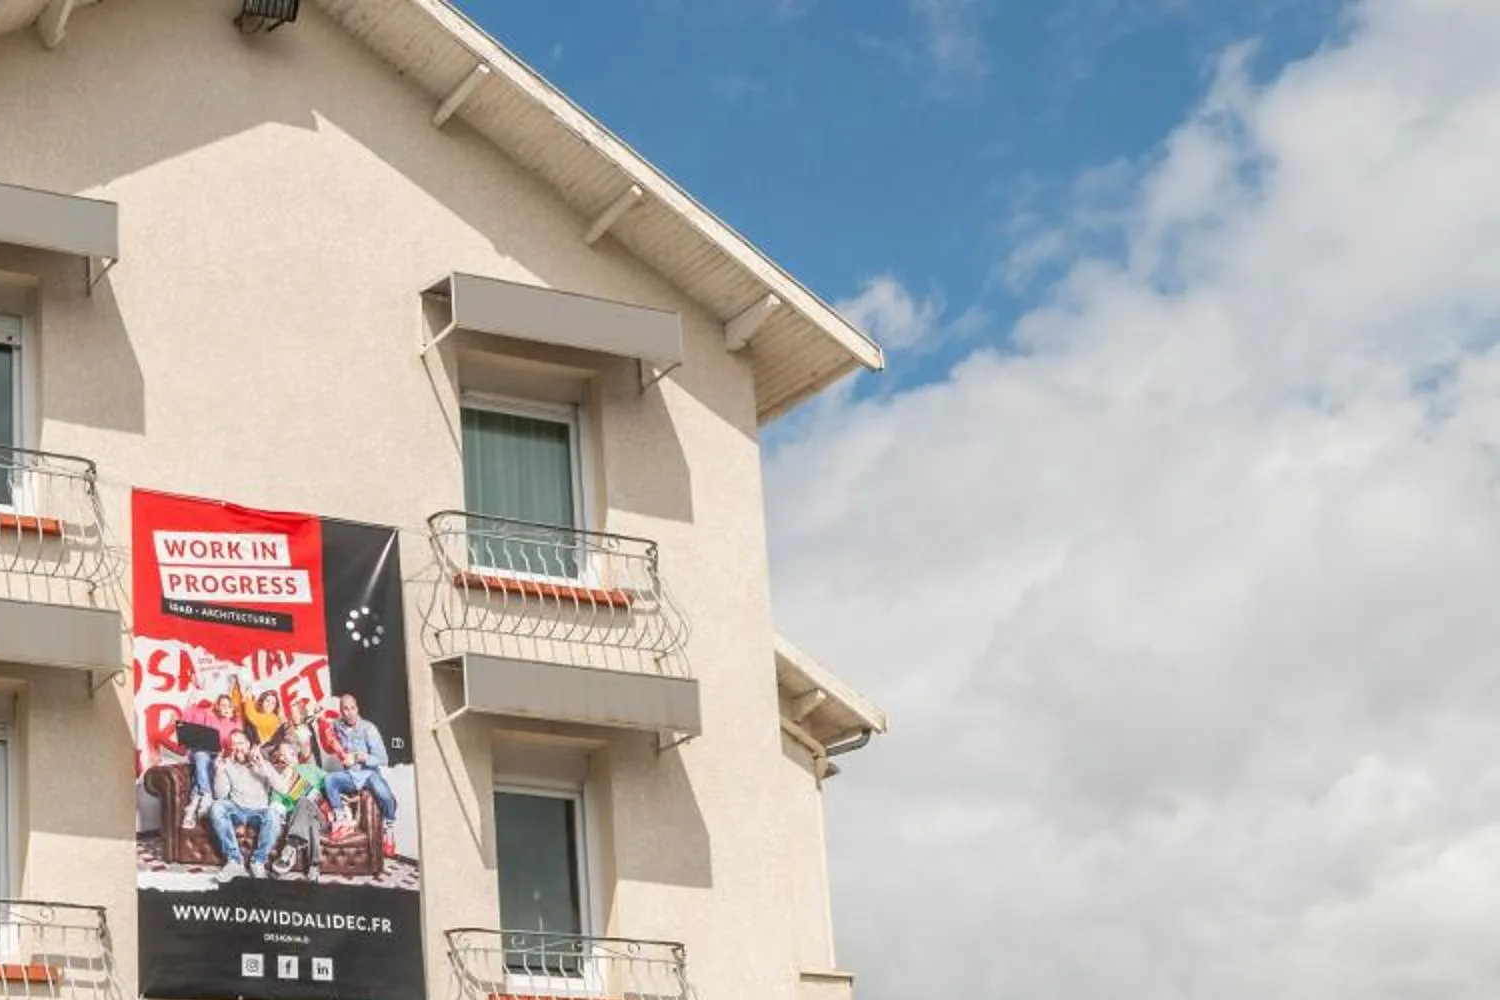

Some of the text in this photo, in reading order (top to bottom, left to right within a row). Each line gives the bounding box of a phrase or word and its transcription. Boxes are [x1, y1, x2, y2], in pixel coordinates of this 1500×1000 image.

[163, 539, 278, 560] WORK IN
[168, 574, 297, 595] PROGRESS
[201, 607, 277, 626] ARCHITECTURES
[172, 904, 392, 933] WWW.DAVIDDALIDEC.FR
